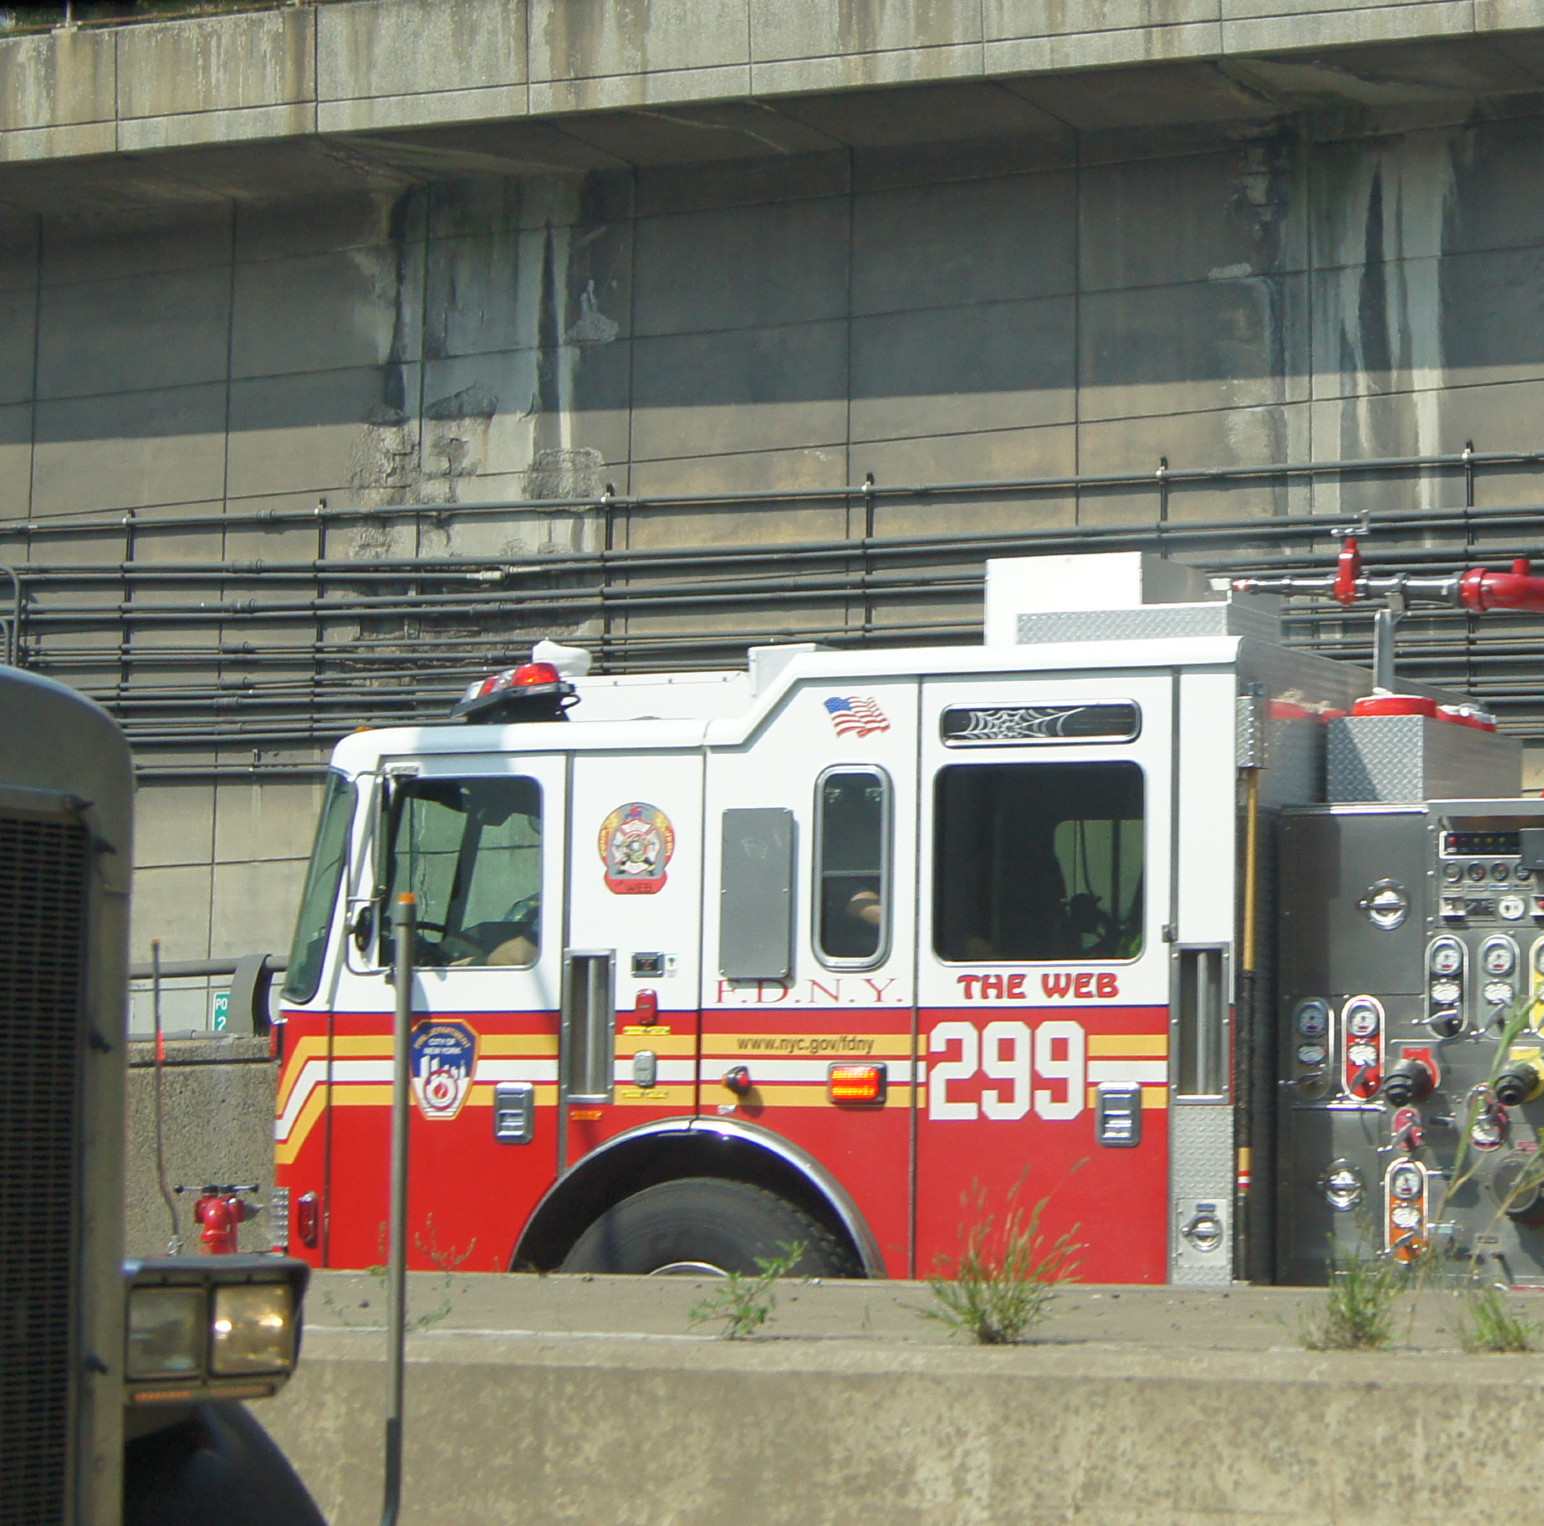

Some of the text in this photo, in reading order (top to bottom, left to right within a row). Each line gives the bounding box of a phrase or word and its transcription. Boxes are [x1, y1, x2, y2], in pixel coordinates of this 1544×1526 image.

[715, 977, 904, 1003] F.D.N.Y.
[956, 973, 1119, 1000] THE WEB
[736, 1035, 876, 1054] www.nyc.gov/fdny
[928, 1020, 1086, 1121] 299
